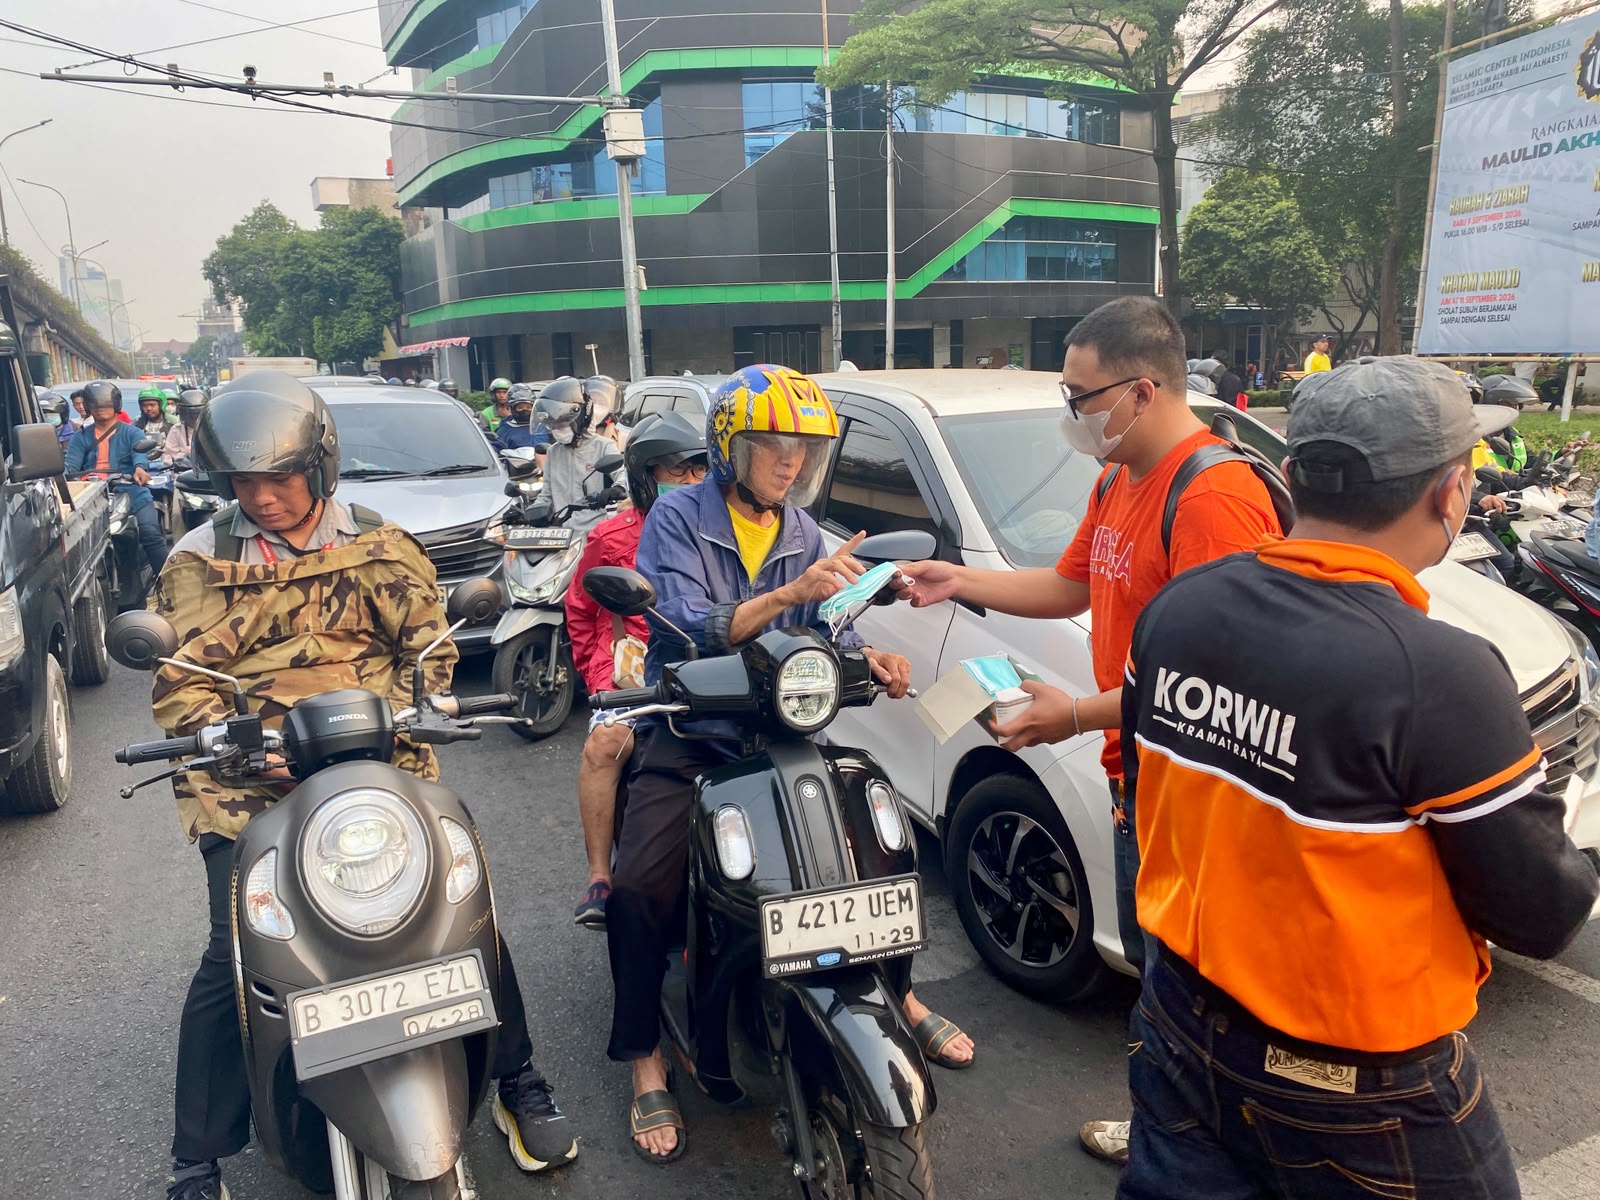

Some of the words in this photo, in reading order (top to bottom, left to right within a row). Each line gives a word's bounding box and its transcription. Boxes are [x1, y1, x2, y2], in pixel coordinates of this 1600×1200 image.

[1452, 66, 1484, 85] ISLAMIC
[1485, 55, 1518, 74] CENTER
[1519, 38, 1571, 62] INDONESIA
[1492, 66, 1520, 81] ALHABIB
[1520, 63, 1532, 73] ALI
[1533, 51, 1569, 69] ALHABSYI
[1477, 81, 1504, 96] JAKARTA
[1531, 114, 1600, 140] RANGKAIA
[1481, 142, 1553, 170] MAULID
[1485, 190, 1493, 209] &
[1493, 184, 1530, 208] ZIARAH
[1443, 229, 1460, 239] PUKUL
[1476, 224, 1488, 234] WIB
[1492, 222, 1504, 232] S/D
[1504, 219, 1530, 230] SELESAI
[1452, 218, 1467, 228] RABU
[1471, 212, 1504, 225] SEPTEMBER
[1440, 271, 1478, 294] KHATAM
[1480, 268, 1521, 291] MAULID
[1437, 306, 1459, 315] SHOLAT
[1459, 305, 1479, 314] SUBUH
[1465, 294, 1498, 304] SEPTEMBER
[1440, 316, 1461, 325] SAMPAI
[1461, 315, 1486, 324] DENGAN
[1487, 314, 1511, 323] SELESAI
[328, 713, 368, 723] HONDA
[1153, 666, 1298, 767] KORWIL
[769, 908, 783, 935] B
[797, 897, 856, 930] 4212
[868, 886, 914, 918] UEM
[848, 952, 886, 964] SEMAKIN
[895, 945, 922, 955] DEPAN
[779, 959, 812, 973] YAMAHA
[303, 1003, 322, 1033] B
[338, 981, 409, 1022] 3072
[424, 965, 476, 1000] EZL
